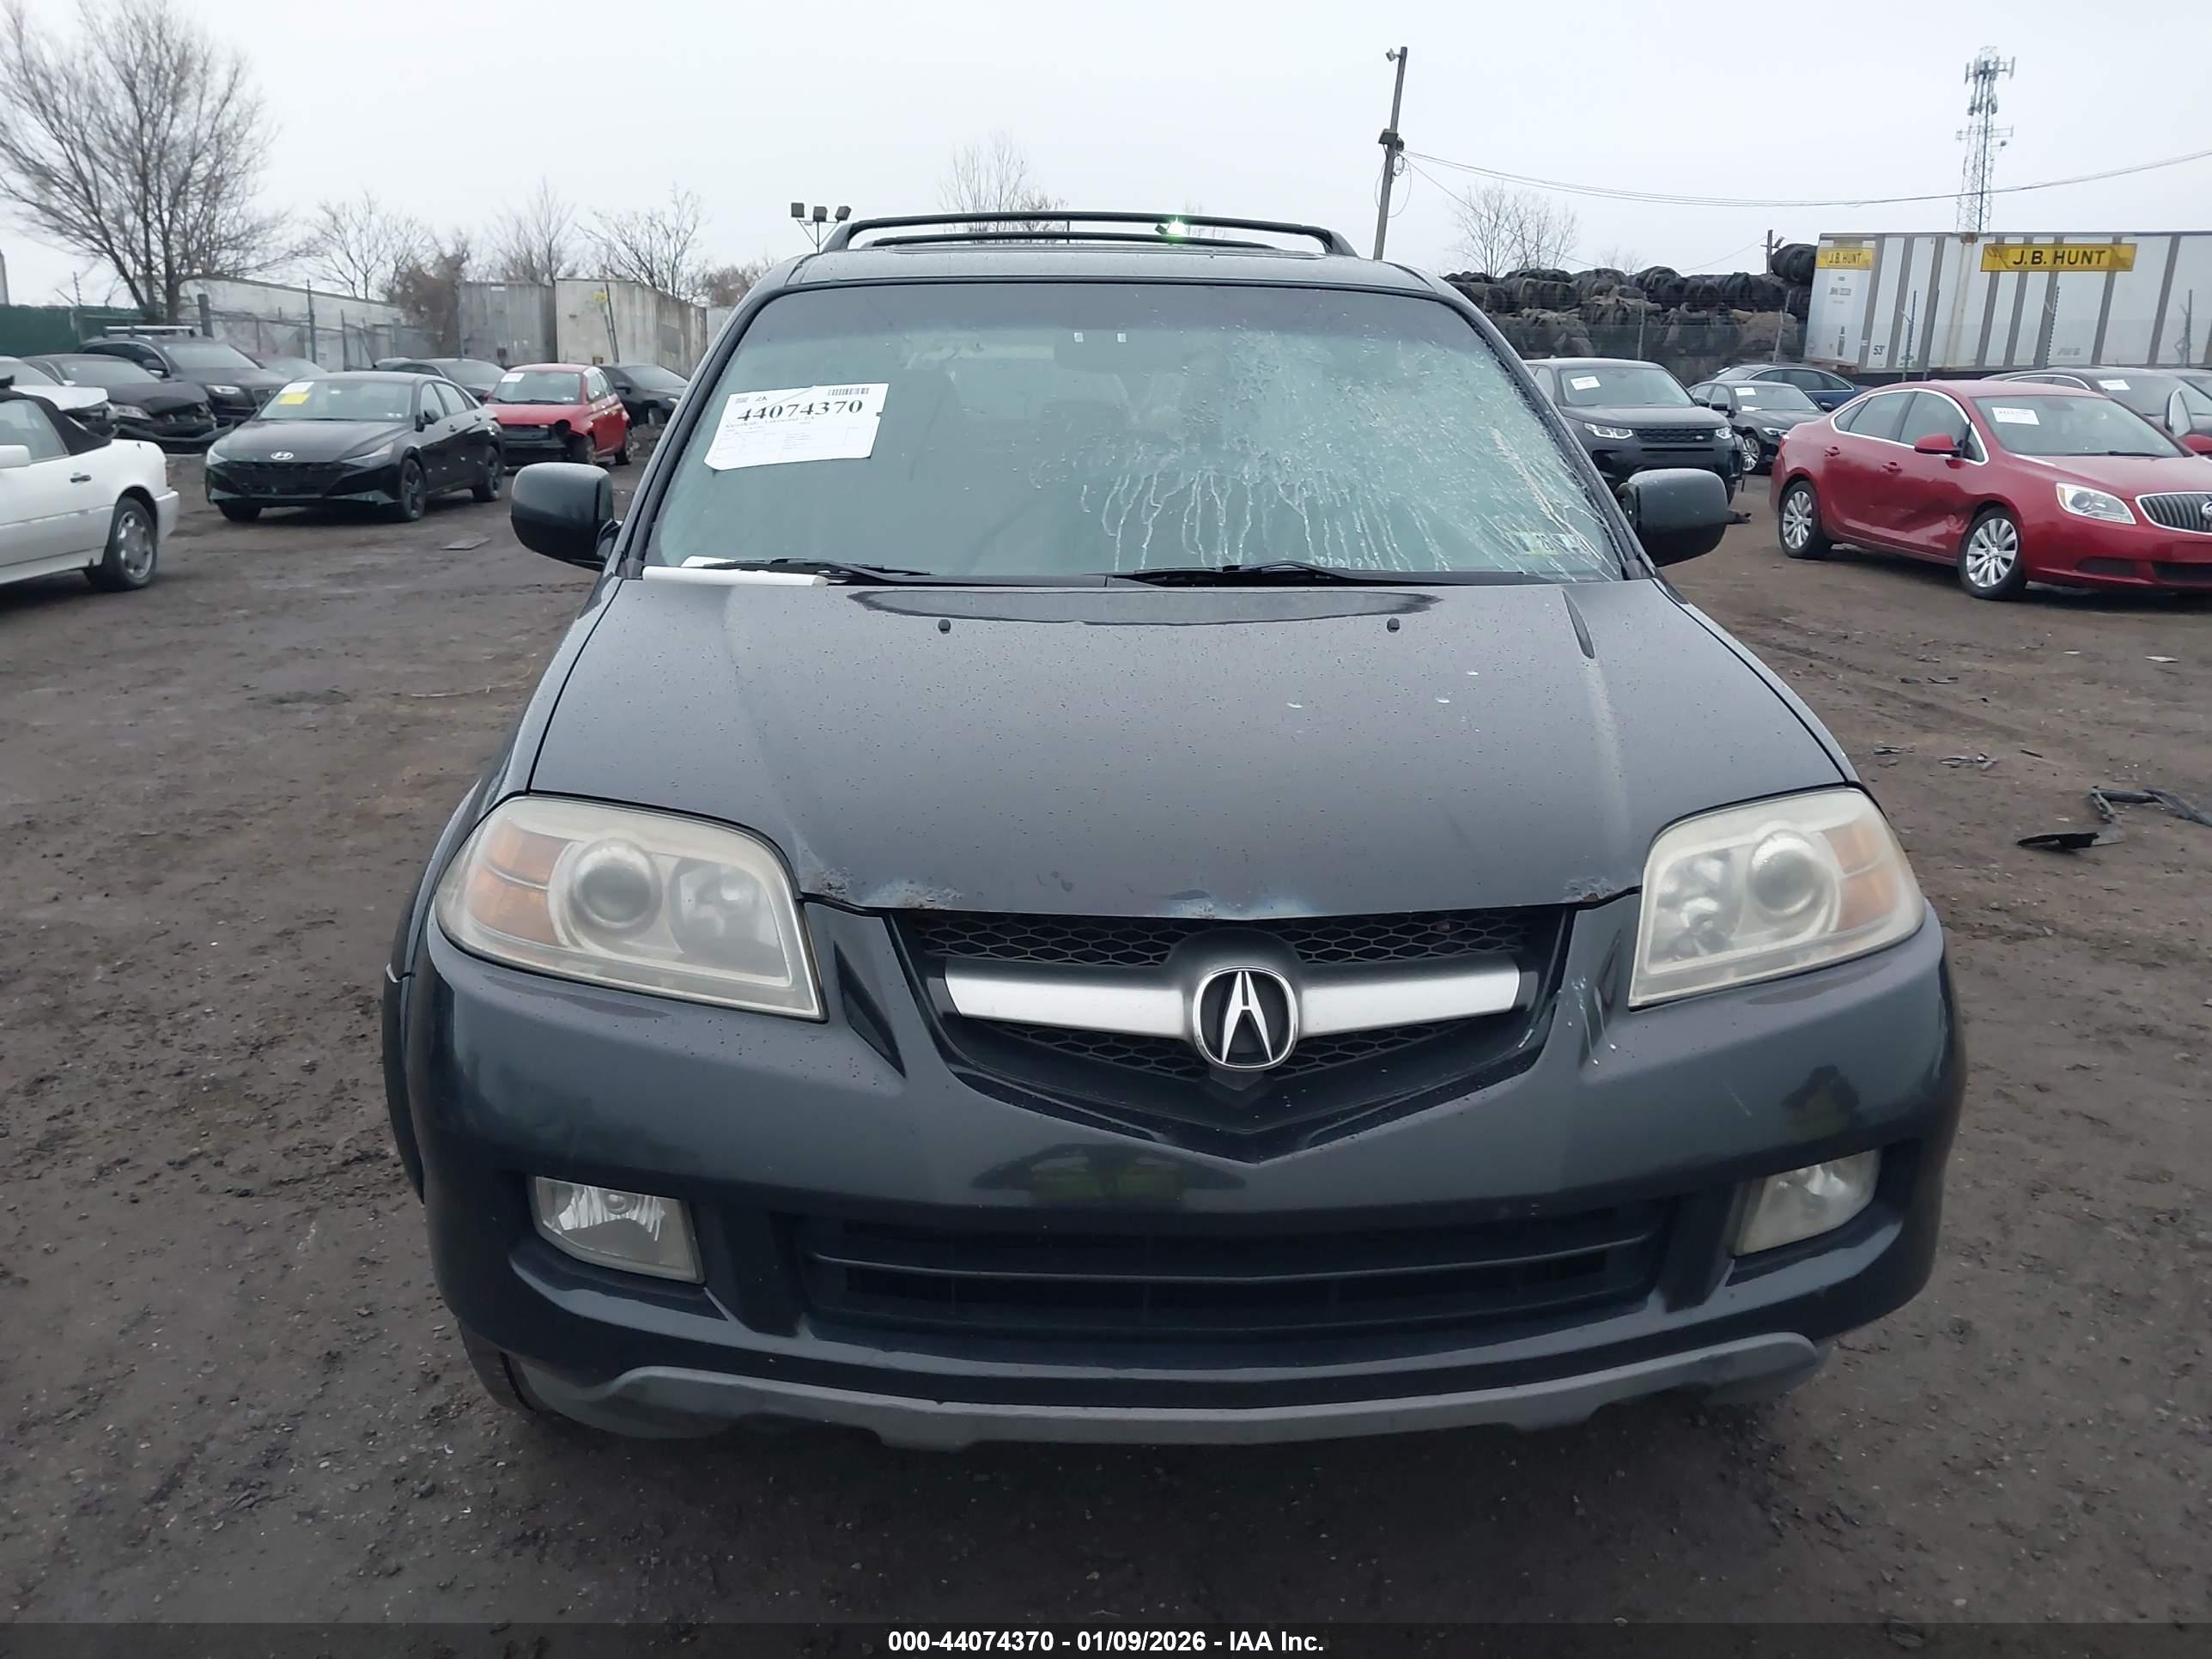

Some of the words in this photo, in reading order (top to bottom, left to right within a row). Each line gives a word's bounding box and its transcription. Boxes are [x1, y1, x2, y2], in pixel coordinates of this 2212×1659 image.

[2013, 250, 2046, 265] J.B.
[2053, 250, 2106, 265] HUNT
[736, 400, 863, 422] 44074370
